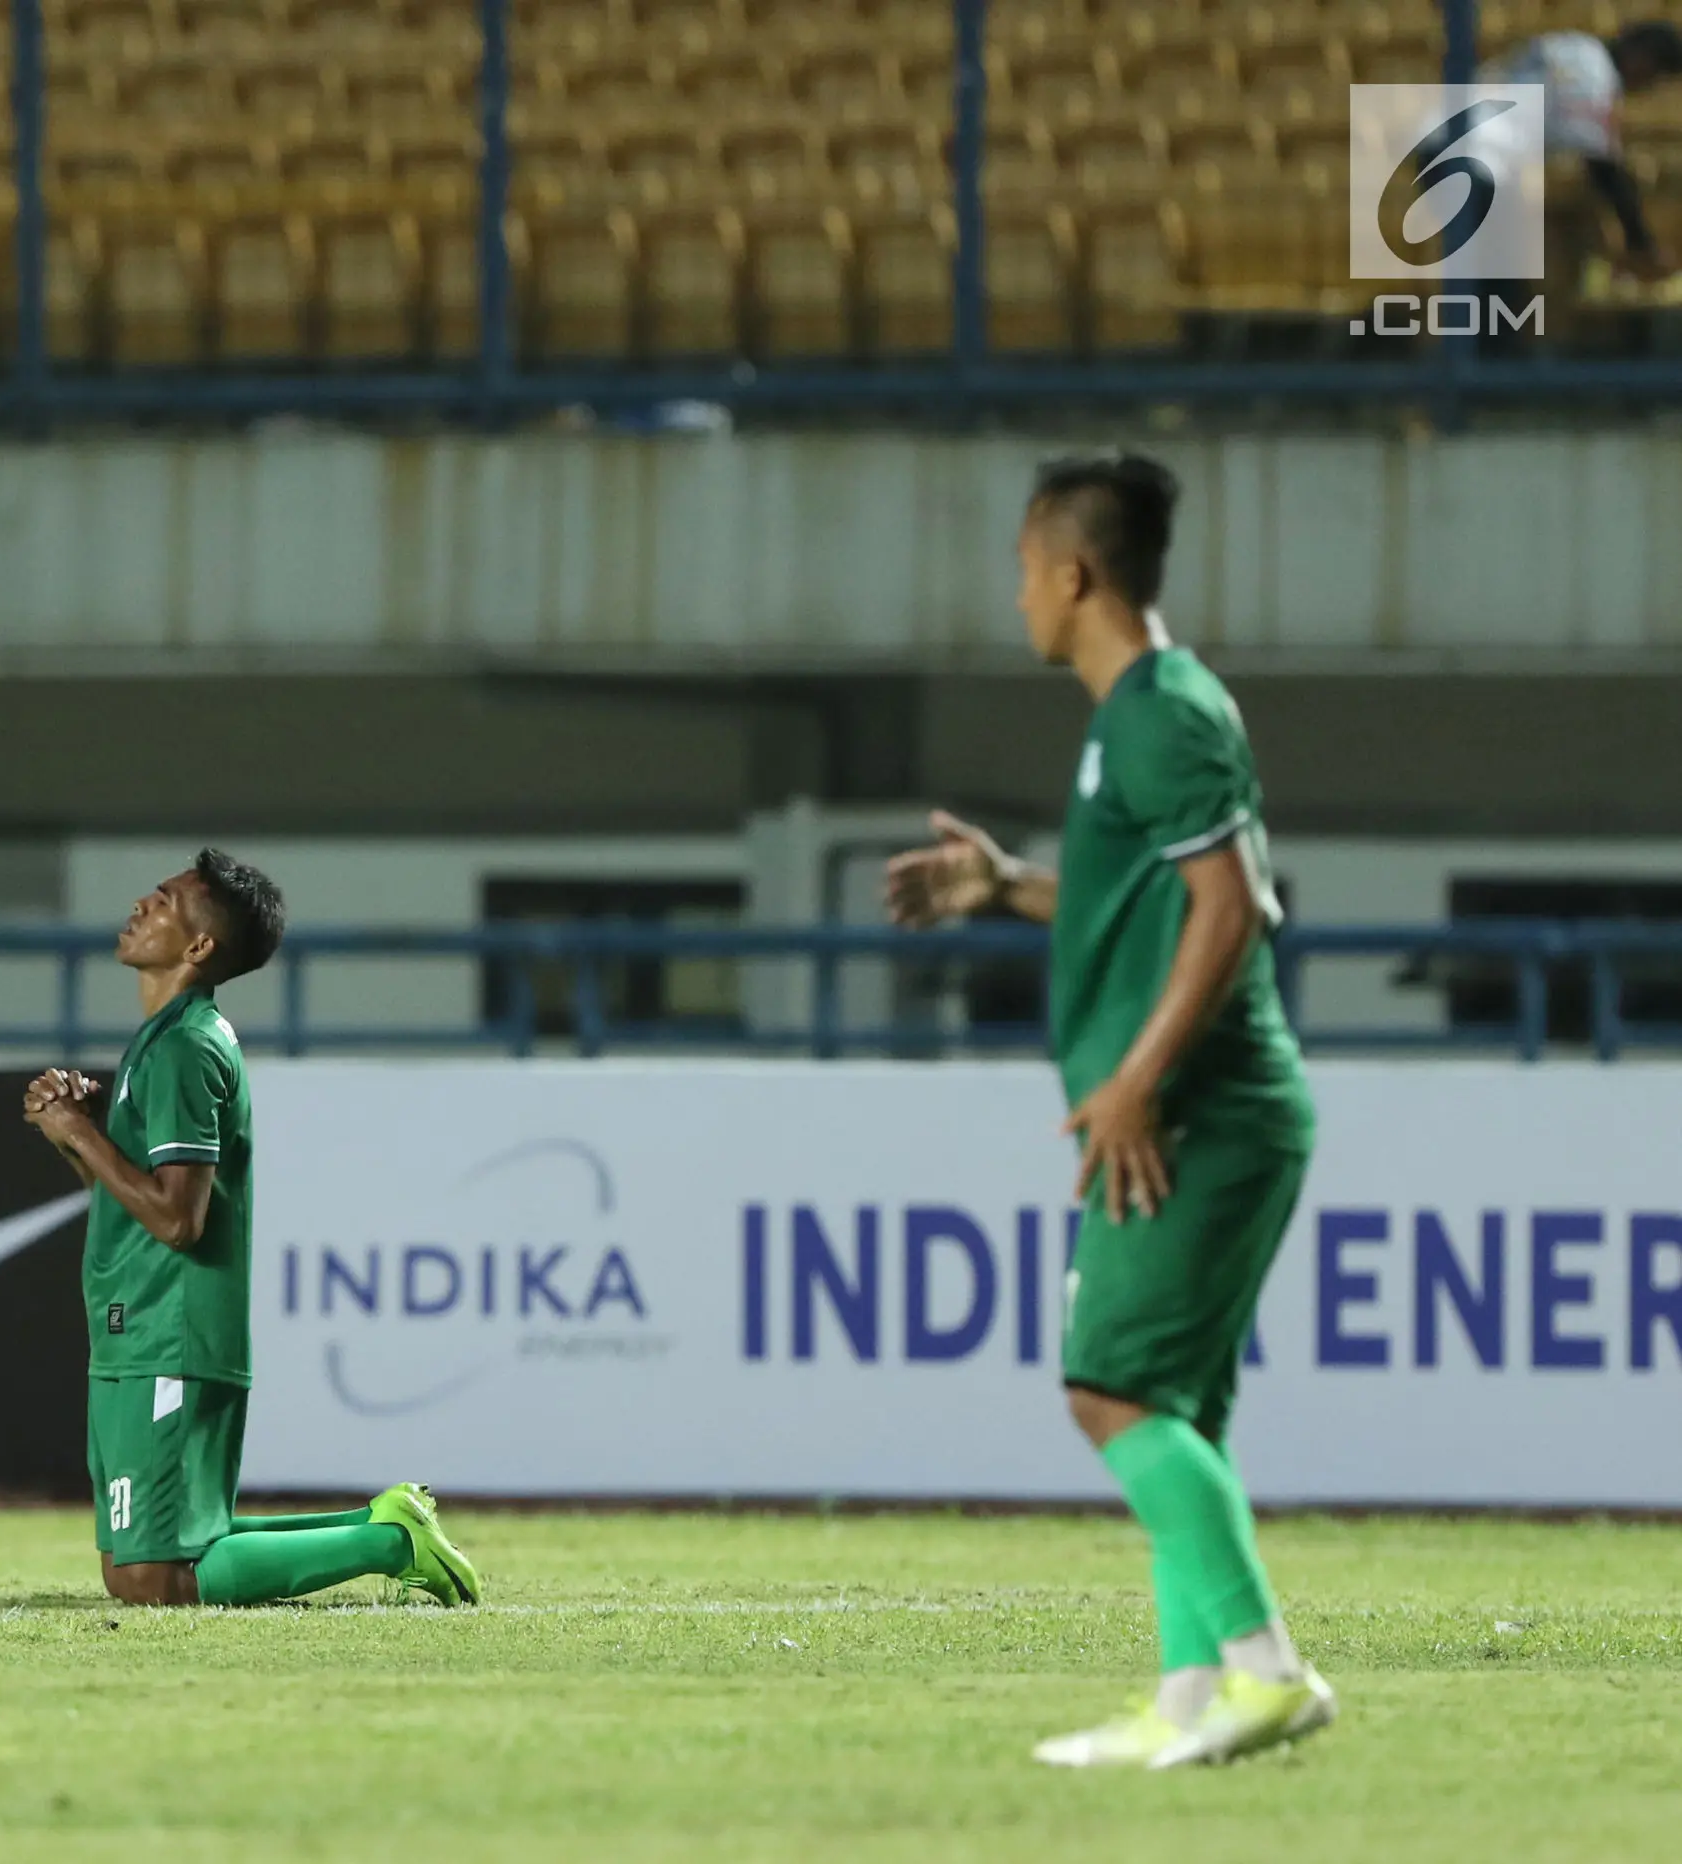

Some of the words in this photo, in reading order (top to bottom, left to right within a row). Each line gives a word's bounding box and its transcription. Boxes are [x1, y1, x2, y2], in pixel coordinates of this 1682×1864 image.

[282, 1243, 648, 1319] INDIKA
[742, 1205, 1264, 1367] INDI
[1315, 1209, 1682, 1371] ENER
[109, 1476, 131, 1532] 21
